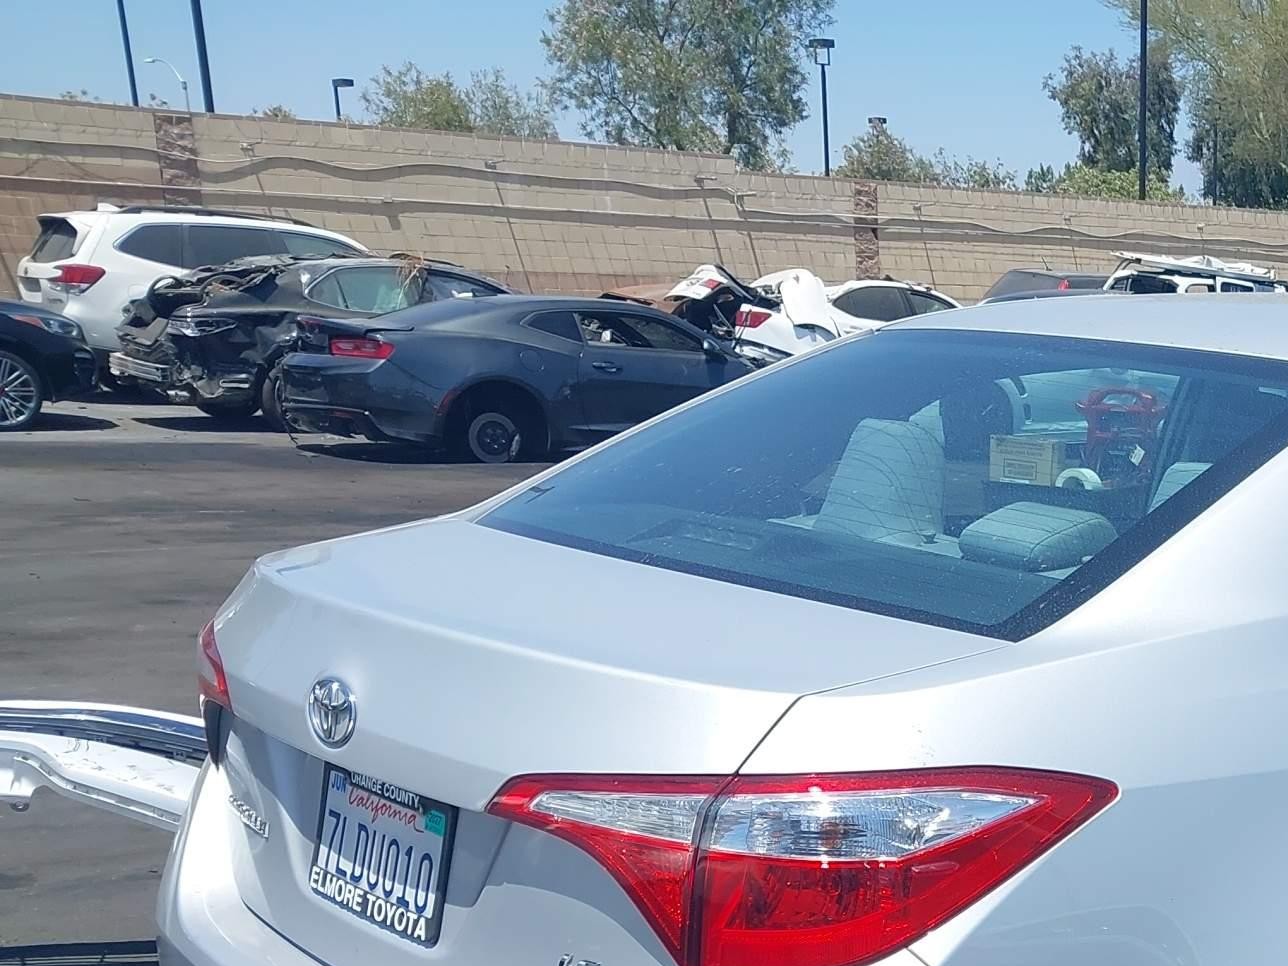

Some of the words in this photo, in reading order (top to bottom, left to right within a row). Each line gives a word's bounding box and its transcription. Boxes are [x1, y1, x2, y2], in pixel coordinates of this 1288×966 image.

[351, 771, 381, 793] ORANGE
[384, 783, 420, 808] COUNTY
[325, 808, 434, 915] 7LDU010
[310, 865, 365, 912] ELMORE
[366, 893, 426, 941] TOYOTA
